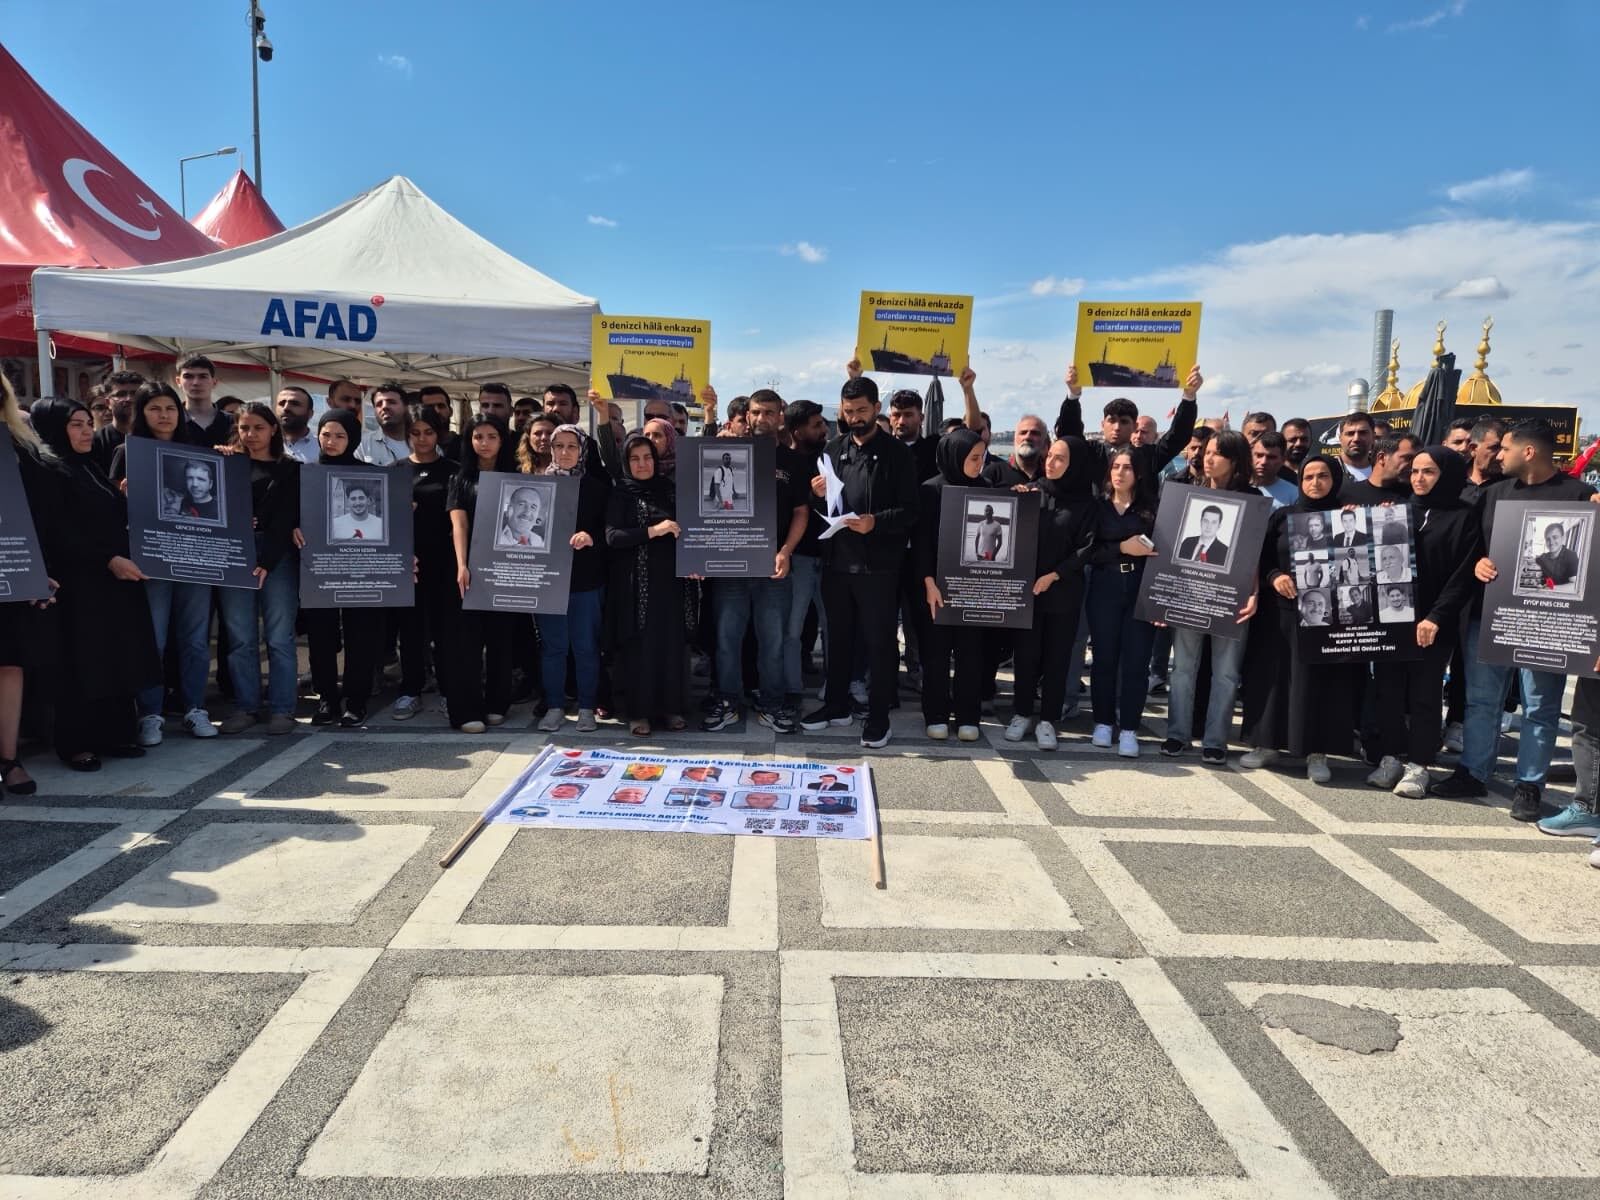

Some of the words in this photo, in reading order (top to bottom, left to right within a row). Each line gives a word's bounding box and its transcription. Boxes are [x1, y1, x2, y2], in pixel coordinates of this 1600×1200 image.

[876, 297, 907, 306] denizci
[908, 297, 926, 307] hâlâ
[928, 299, 964, 309] enkazda
[876, 311, 908, 320] onlardan
[908, 313, 954, 323] vazgeçmeyin
[1087, 308, 1093, 316] 9
[1095, 308, 1128, 317] denizci
[1130, 308, 1149, 317] hâlâ
[1152, 308, 1192, 317] enkazda
[260, 298, 377, 342] AFAD
[601, 321, 607, 329] 9
[610, 321, 641, 330] denizci
[664, 323, 702, 333] enkazda
[1095, 322, 1129, 331] onlardan
[1130, 323, 1180, 333] vazgeçmeyin
[610, 336, 644, 344] onlardan
[645, 337, 692, 347] vazgeçmeyin
